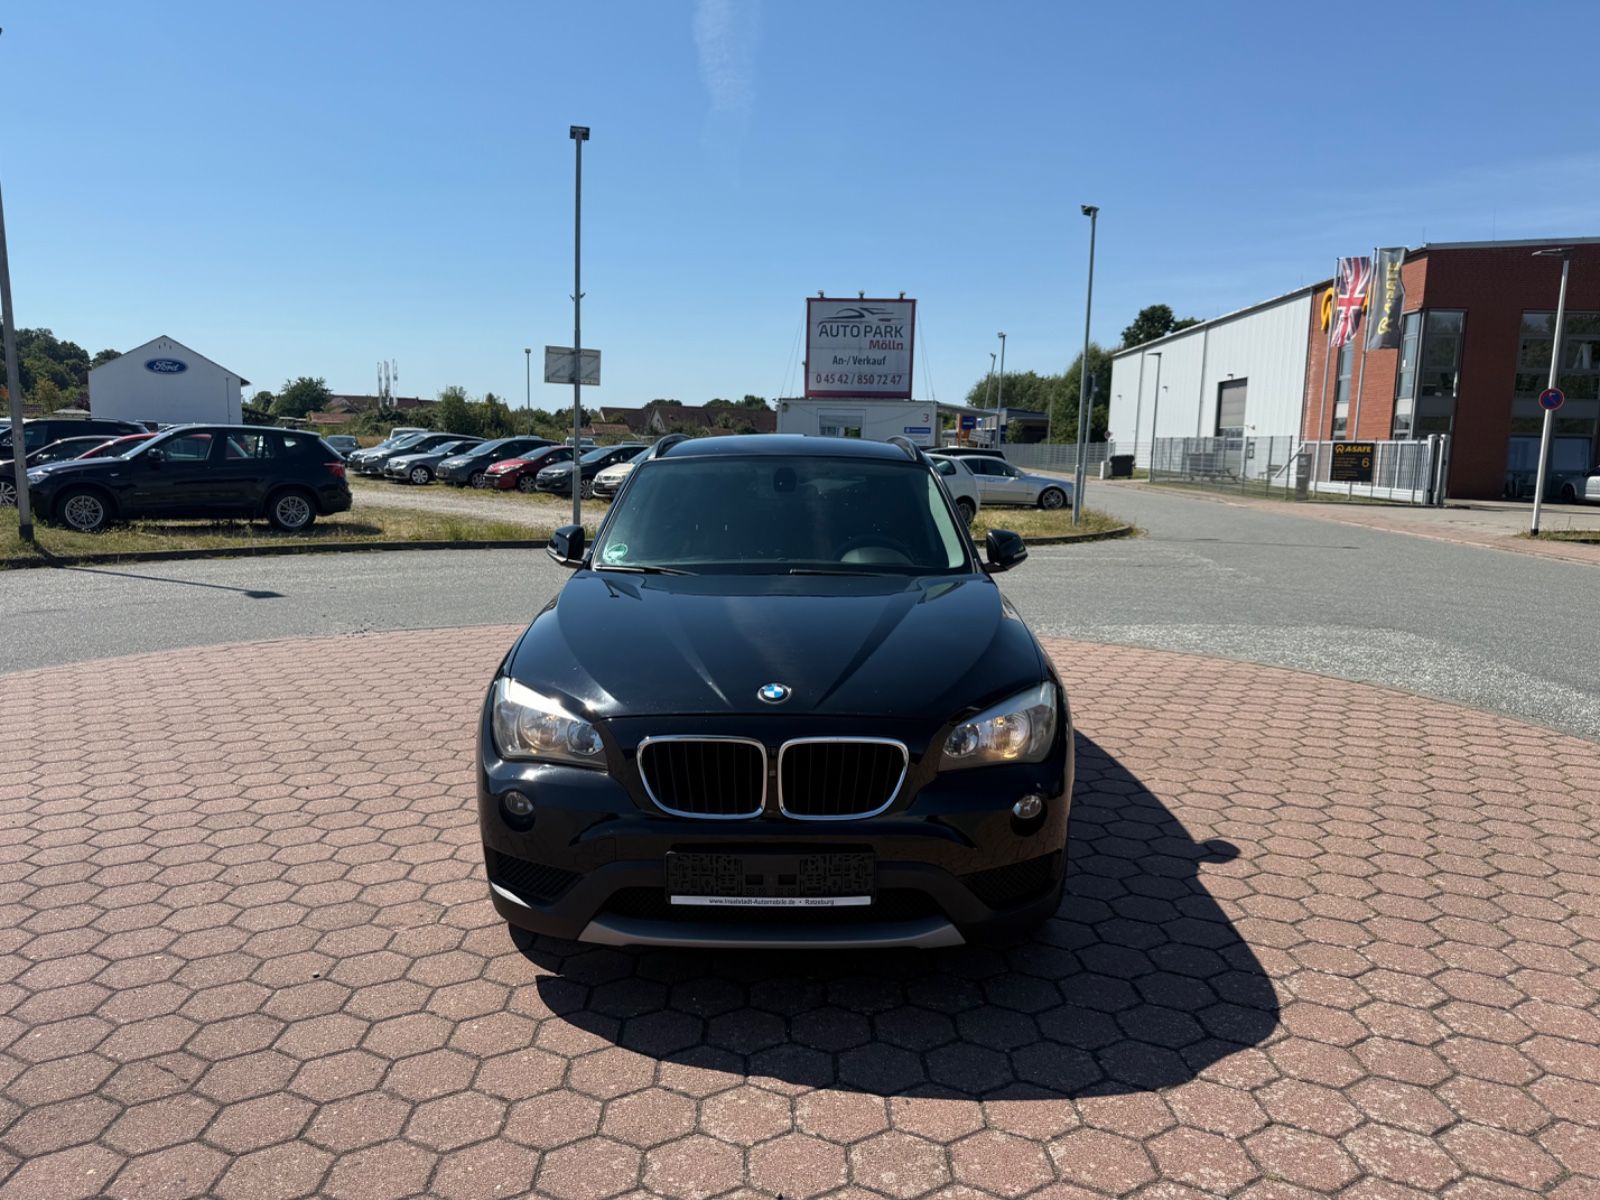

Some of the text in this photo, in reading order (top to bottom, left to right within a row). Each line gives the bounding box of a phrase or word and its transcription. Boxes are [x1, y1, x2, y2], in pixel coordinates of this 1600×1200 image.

[818, 324, 904, 338] AUTO PARK
[868, 339, 904, 350] Mölln
[852, 355, 886, 366] Verkauf
[153, 361, 179, 372] Ford
[824, 374, 835, 384] 45
[837, 374, 849, 384] 42
[857, 374, 874, 385] 850
[877, 374, 888, 385] 72
[890, 375, 902, 385] 47
[922, 413, 929, 423] 3
[1361, 457, 1370, 468] 6
